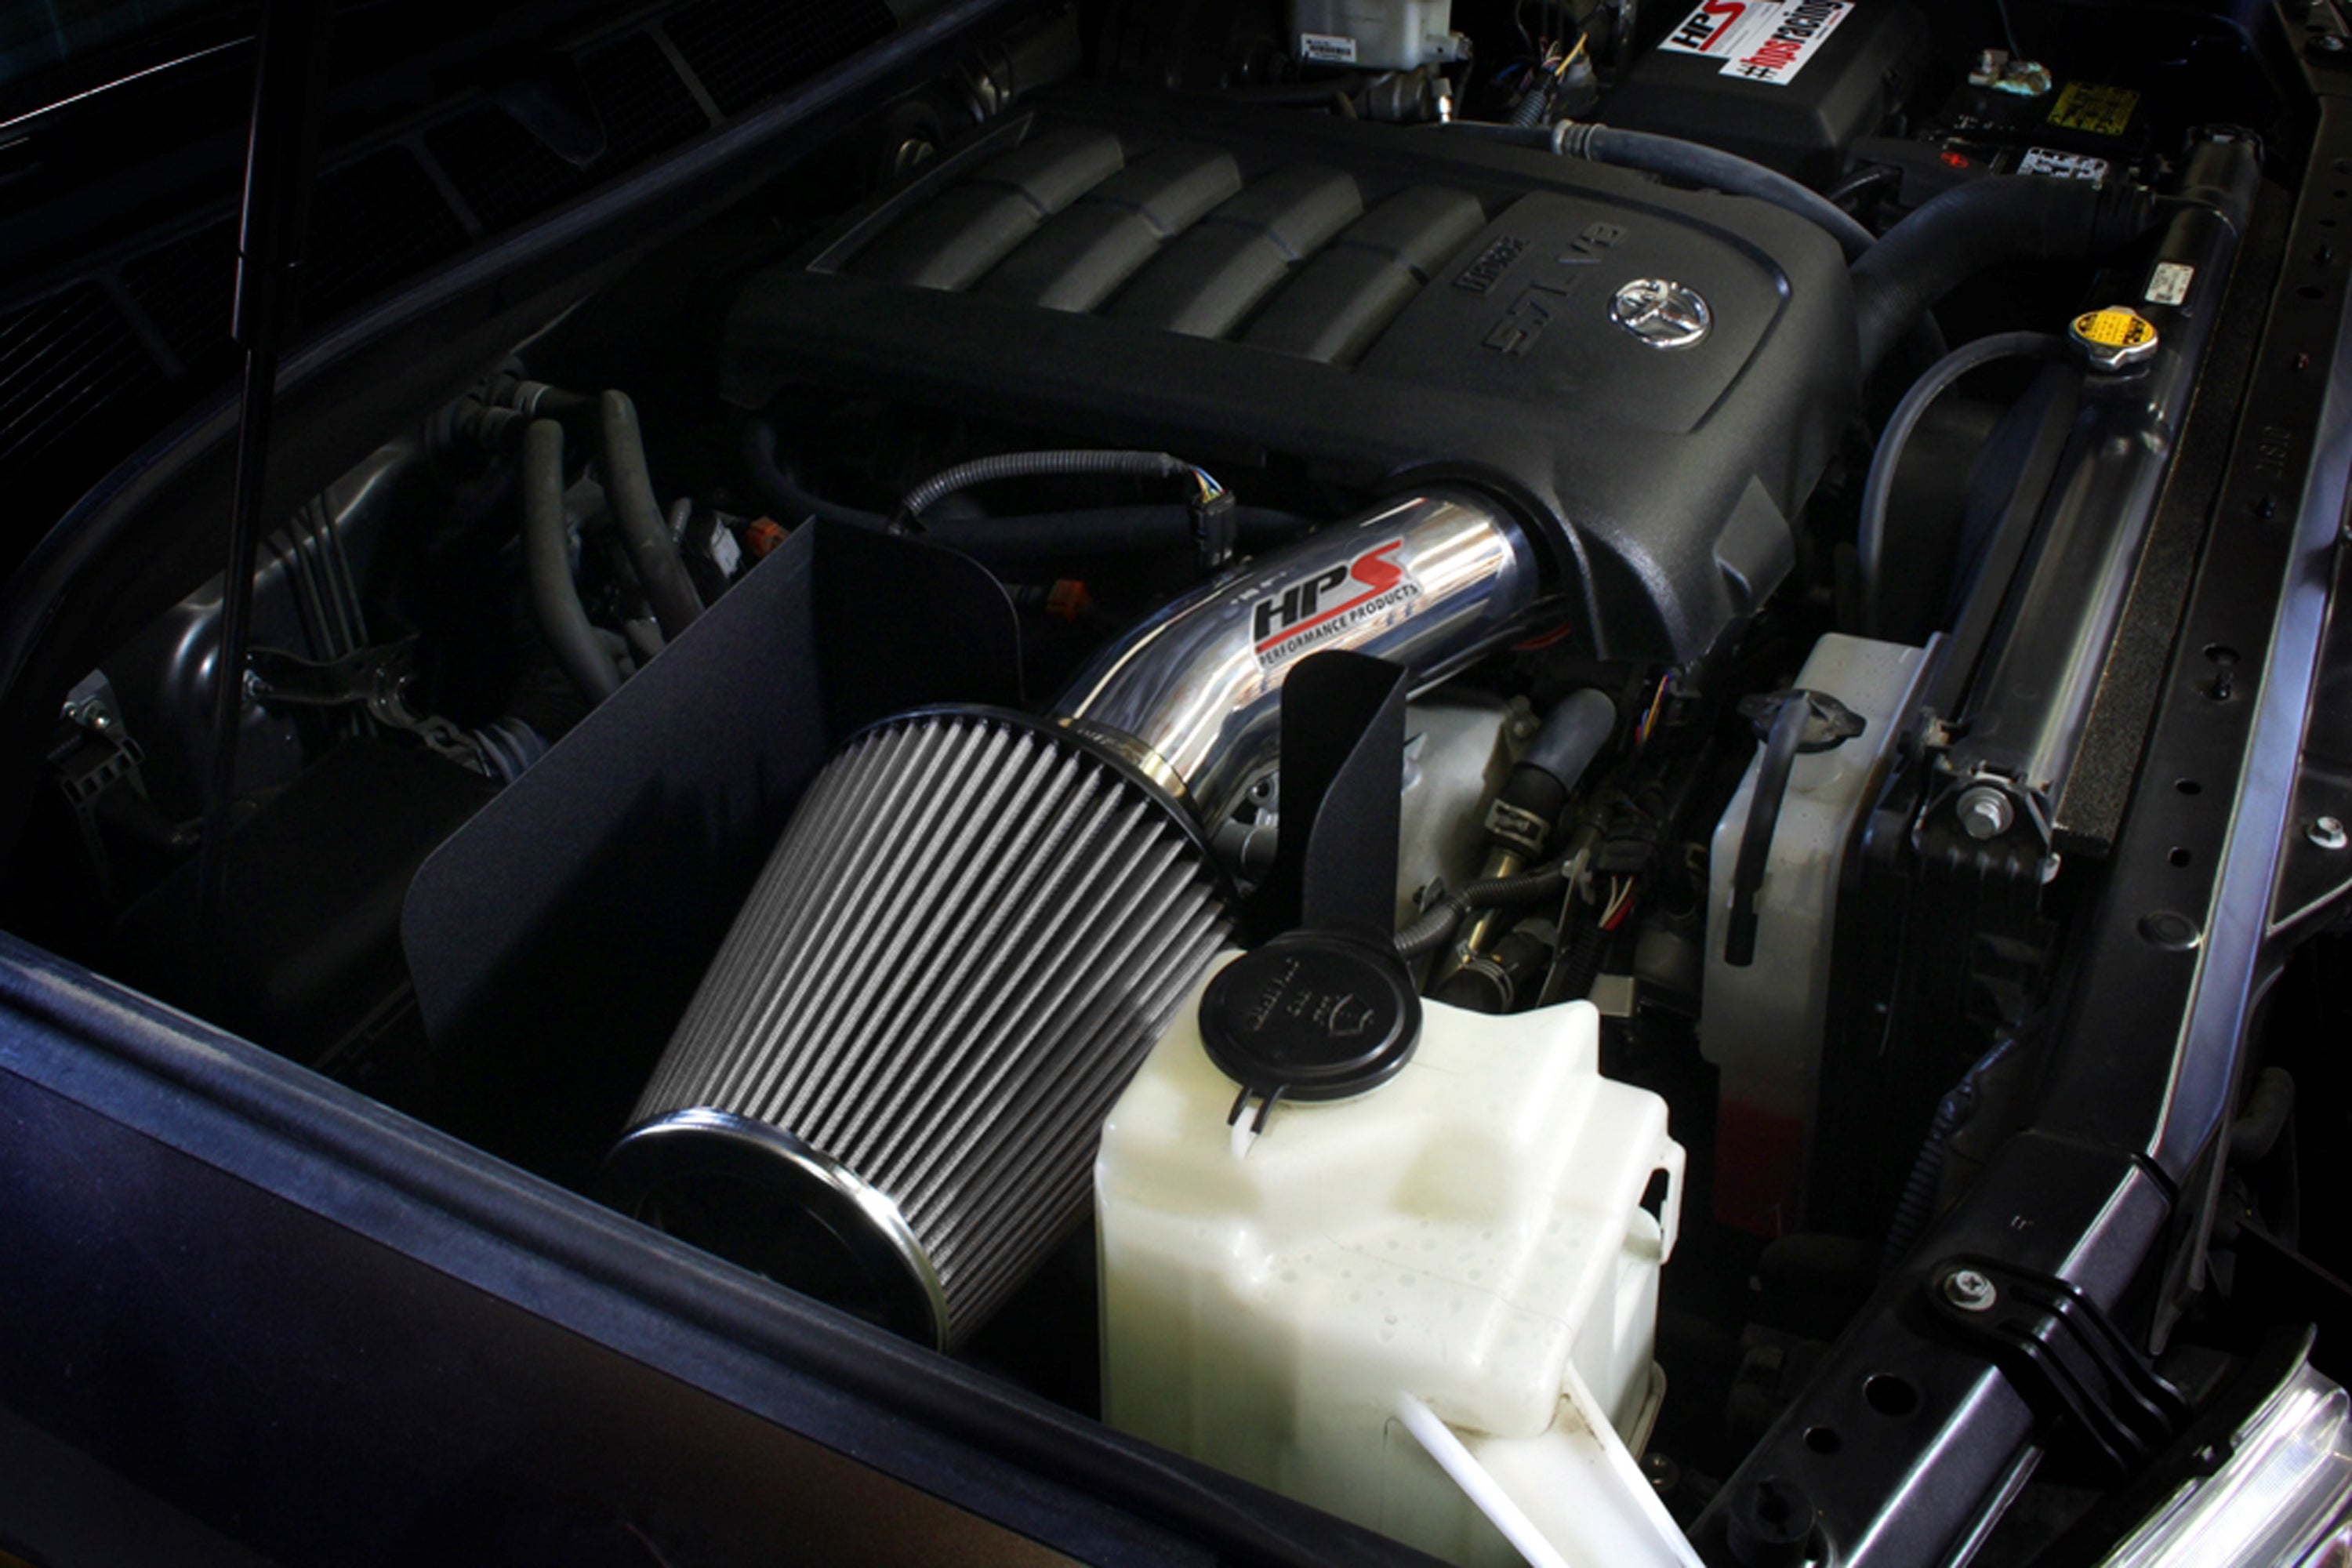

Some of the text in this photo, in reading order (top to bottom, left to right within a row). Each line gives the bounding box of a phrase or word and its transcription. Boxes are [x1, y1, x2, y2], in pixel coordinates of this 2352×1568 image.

[1671, 0, 1746, 52] HPS
[1254, 539, 1402, 654] HPS
[1259, 584, 1419, 666] PERFORMANCE PRODUCTS
